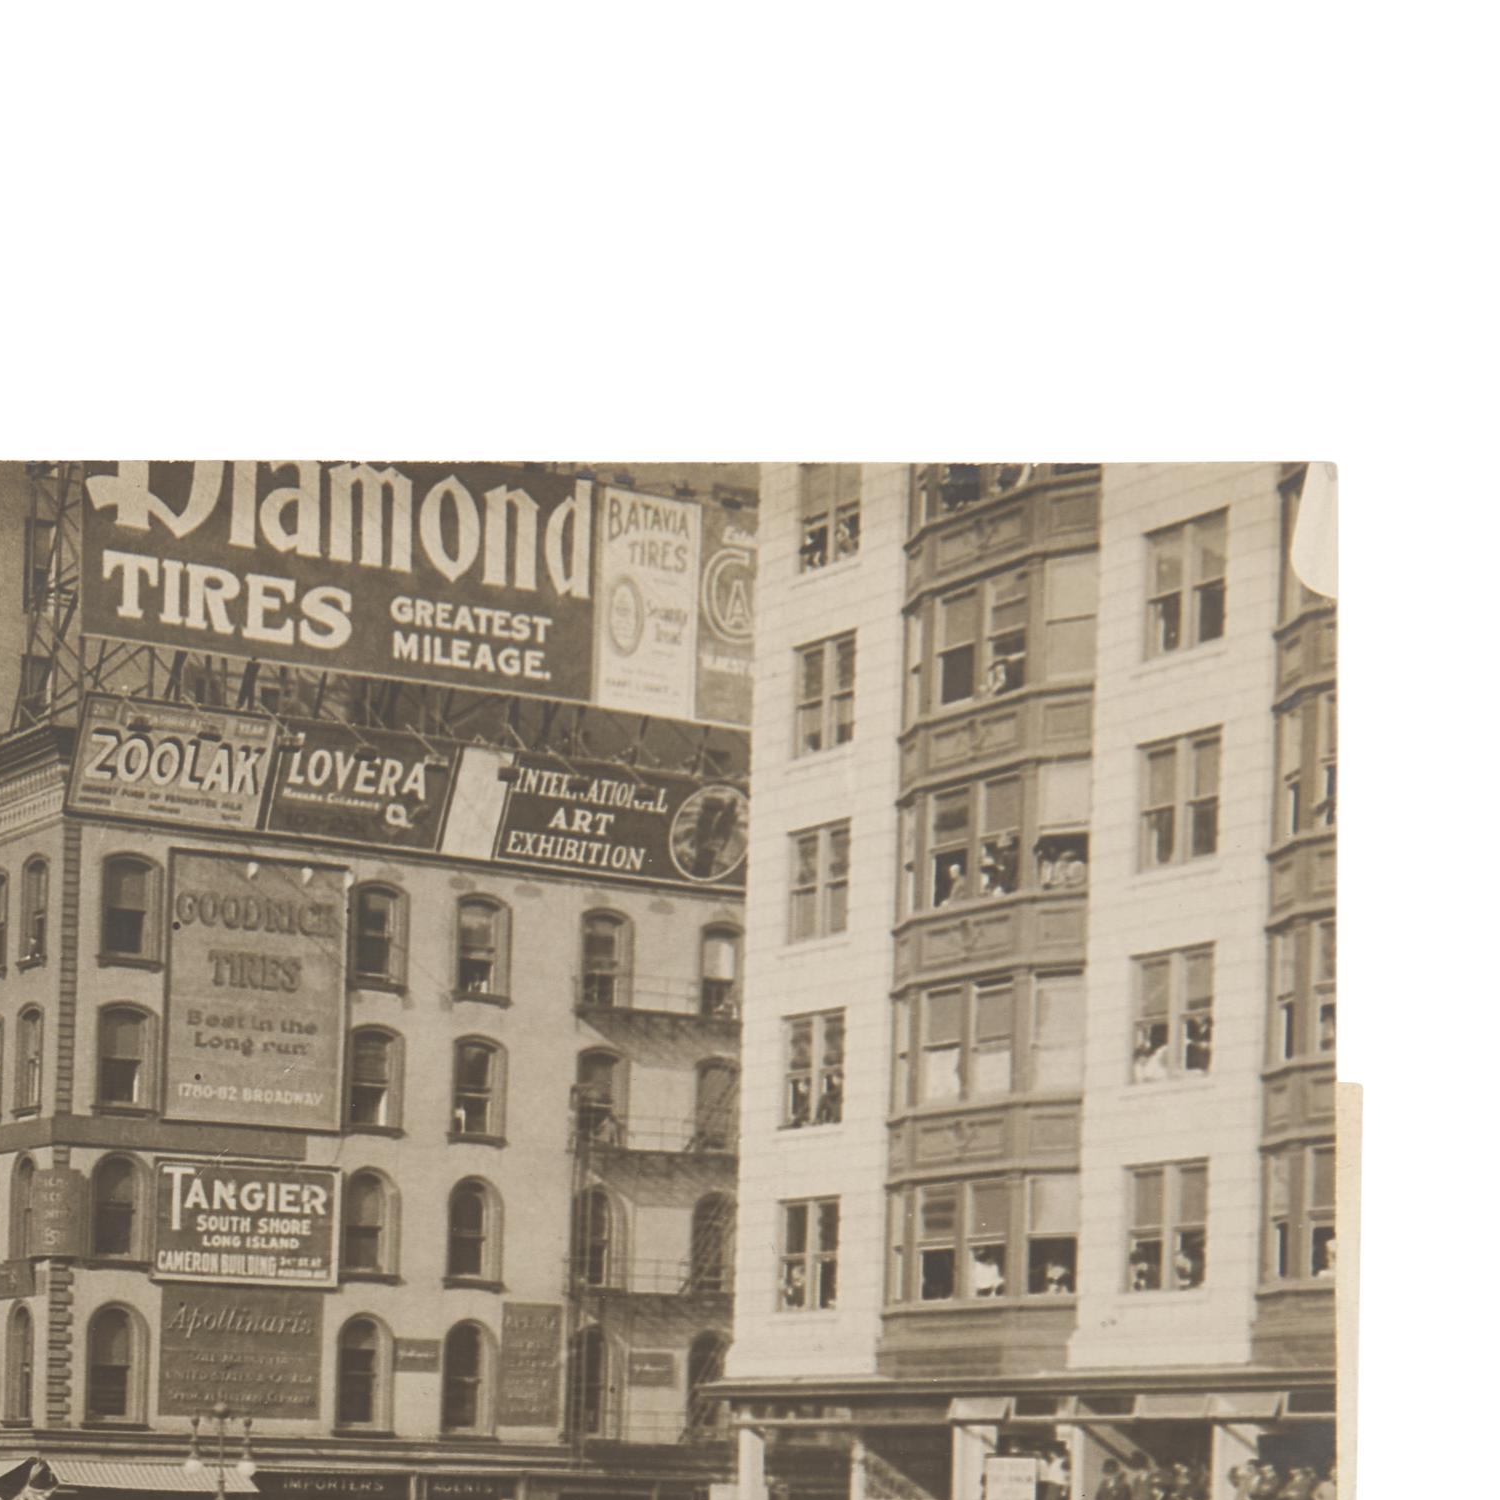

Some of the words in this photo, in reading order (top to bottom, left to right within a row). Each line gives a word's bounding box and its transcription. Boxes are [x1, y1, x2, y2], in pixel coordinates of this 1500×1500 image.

[85, 460, 592, 600] Diamond
[608, 497, 690, 542] BATAVIA
[628, 540, 688, 573] TIRES
[102, 549, 352, 649] TIRES
[389, 595, 553, 644] GREATEST
[392, 630, 552, 681] MILEAGE.
[84, 729, 265, 796] ZOOLAK
[287, 733, 426, 801] LOVERA
[548, 806, 615, 835] ART
[506, 831, 646, 870] EXHIBITION
[207, 949, 302, 993] TIRES
[186, 1009, 245, 1030] Best
[251, 1014, 274, 1032] in
[280, 1018, 318, 1036] the
[193, 1031, 254, 1057] Long
[178, 1083, 238, 1102] 1780-82
[241, 1087, 324, 1107] BROADWAY
[162, 1166, 328, 1231] TANGIER
[195, 1214, 251, 1233] SOUTH
[257, 1217, 312, 1236] SHORE
[201, 1235, 242, 1247] LONG
[245, 1237, 300, 1250] ISLAND
[156, 1250, 219, 1273] CAMERON
[220, 1253, 277, 1277] BUILDING
